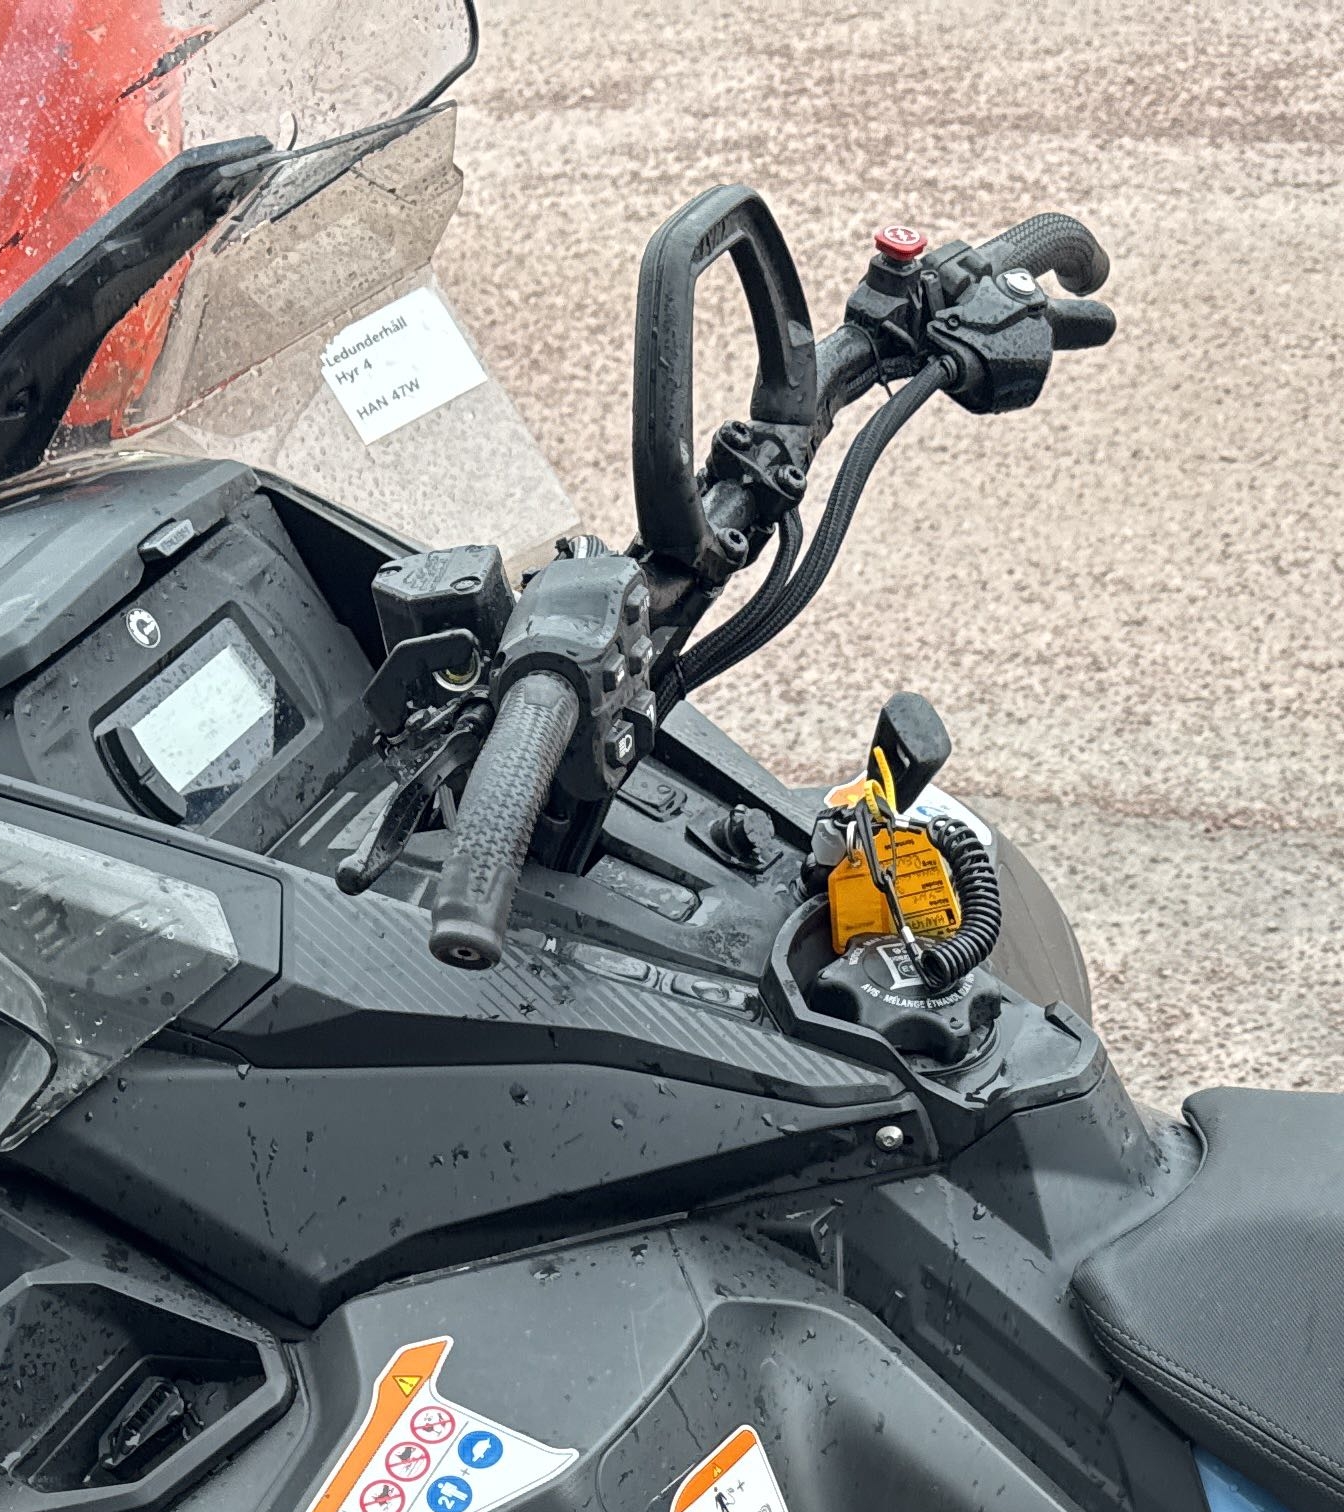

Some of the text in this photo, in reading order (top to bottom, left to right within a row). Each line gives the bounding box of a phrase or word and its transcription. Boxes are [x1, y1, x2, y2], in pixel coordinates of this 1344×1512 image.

[325, 315, 408, 368] Ledunderhåll
[335, 357, 373, 386] Hyr 4
[356, 377, 421, 420] HAN 47W
[882, 994, 926, 1009] MÉLANGE
